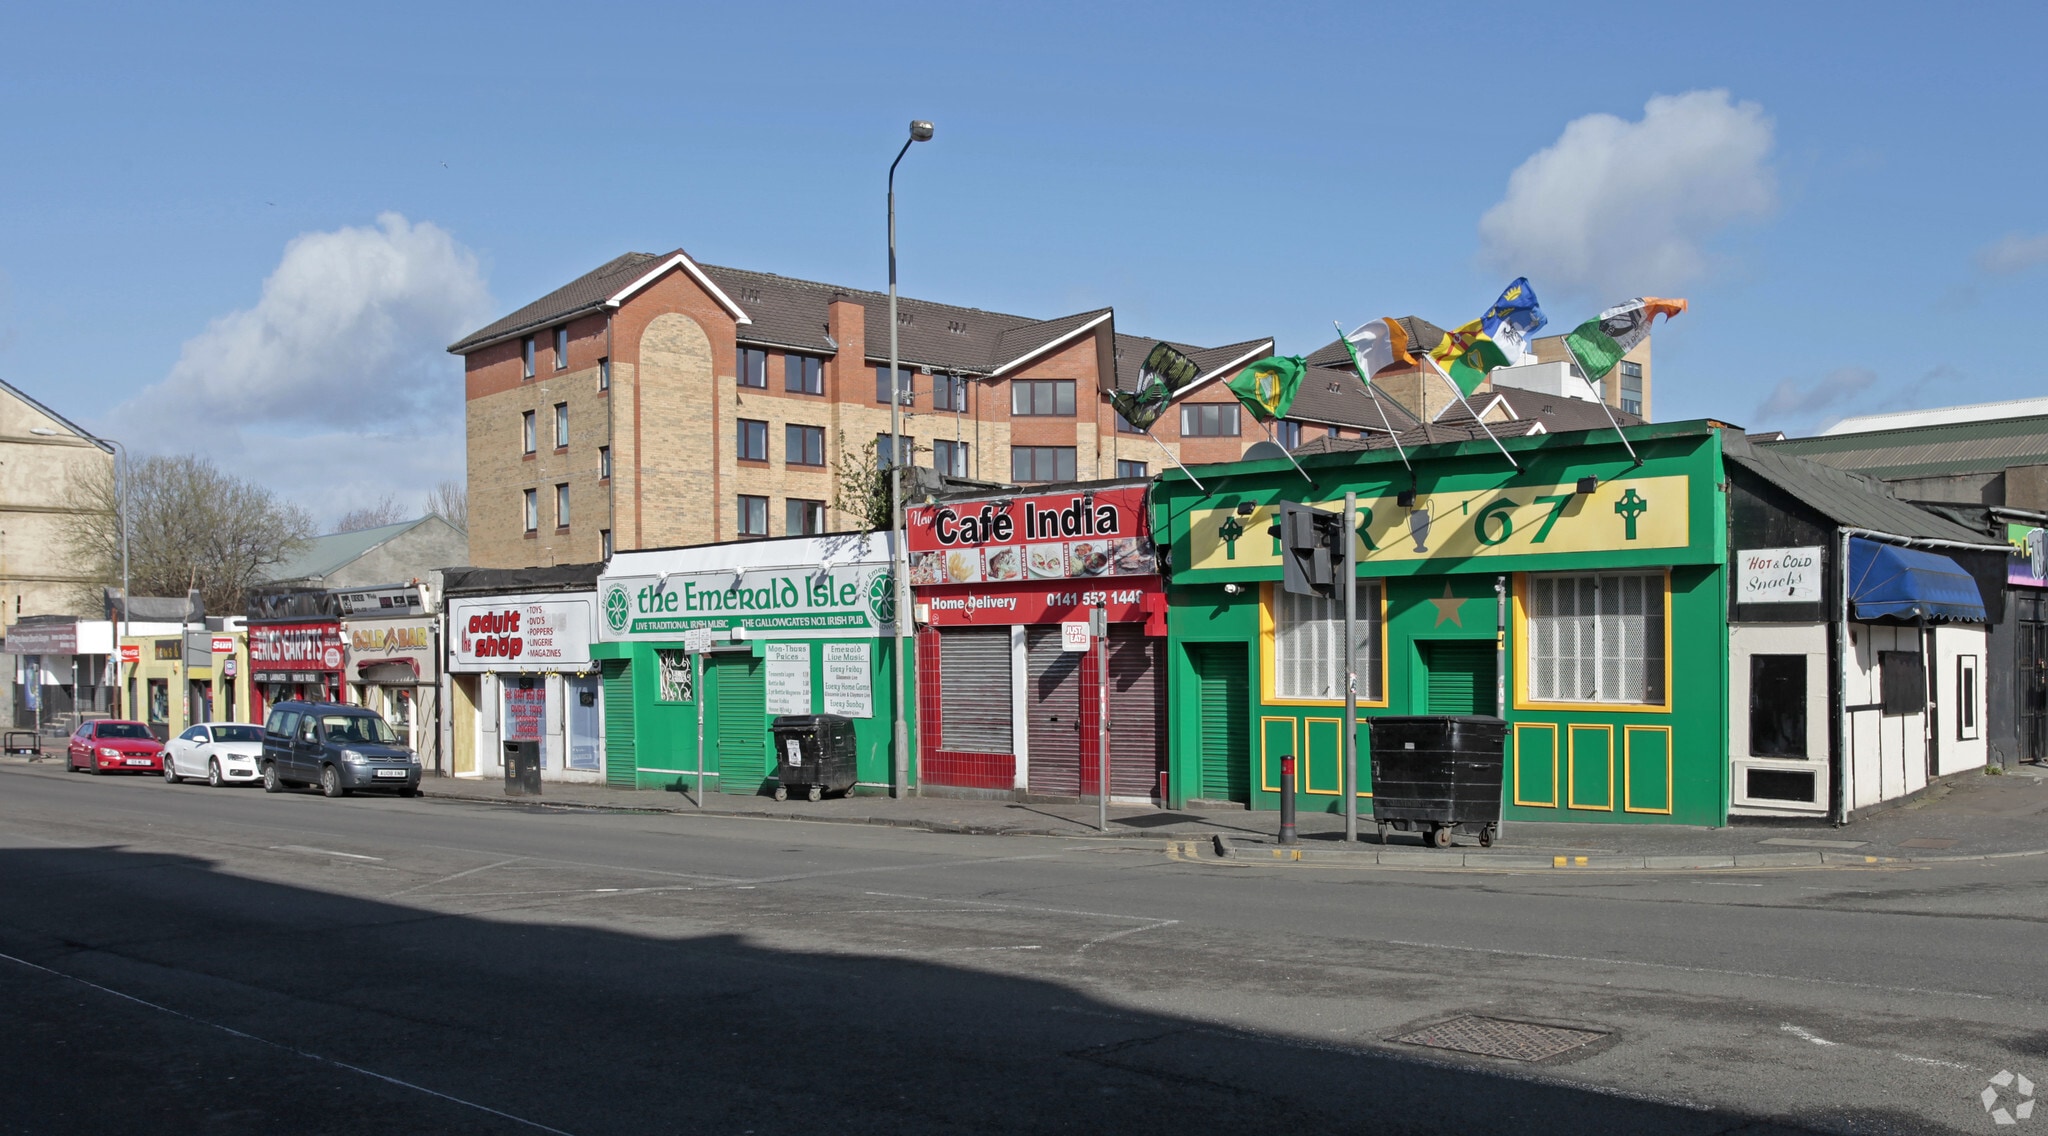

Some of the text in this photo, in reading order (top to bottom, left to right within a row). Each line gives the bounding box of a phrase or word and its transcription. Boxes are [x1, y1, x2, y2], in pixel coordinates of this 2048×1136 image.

[911, 497, 1119, 545] New Café India
[1749, 554, 1812, 570] HOT & COLD
[637, 575, 857, 613] the Emerald Isle
[931, 597, 965, 610] Home
[968, 595, 1017, 611] Delivery
[1046, 592, 1077, 607] 0141
[1082, 591, 1107, 606] 552
[529, 606, 543, 614] TOYS
[468, 610, 521, 635] adult
[529, 616, 546, 626] DVD'S
[635, 619, 729, 630] LIVE TRADITIONAL IRISH MUSIC
[741, 617, 755, 628] THE
[810, 616, 827, 626] NO1
[827, 615, 848, 626] IRISH
[848, 615, 864, 625] PUB
[529, 627, 554, 636] POPPERS
[1066, 625, 1082, 635] JUST
[352, 629, 386, 652] GOLD
[397, 626, 428, 650] BAR
[461, 626, 472, 653] the
[529, 638, 553, 647] LINGERIE
[1070, 634, 1082, 643] EAT
[212, 640, 232, 650] Sun
[282, 628, 323, 661] CARPETS
[475, 635, 523, 661] shop
[831, 645, 862, 653] Emerald
[529, 648, 562, 658] MAGAZINES
[776, 652, 799, 660] Prices
[827, 653, 865, 661] Live Music
[830, 664, 863, 674] Every Friday
[825, 682, 870, 691] Every Home Game
